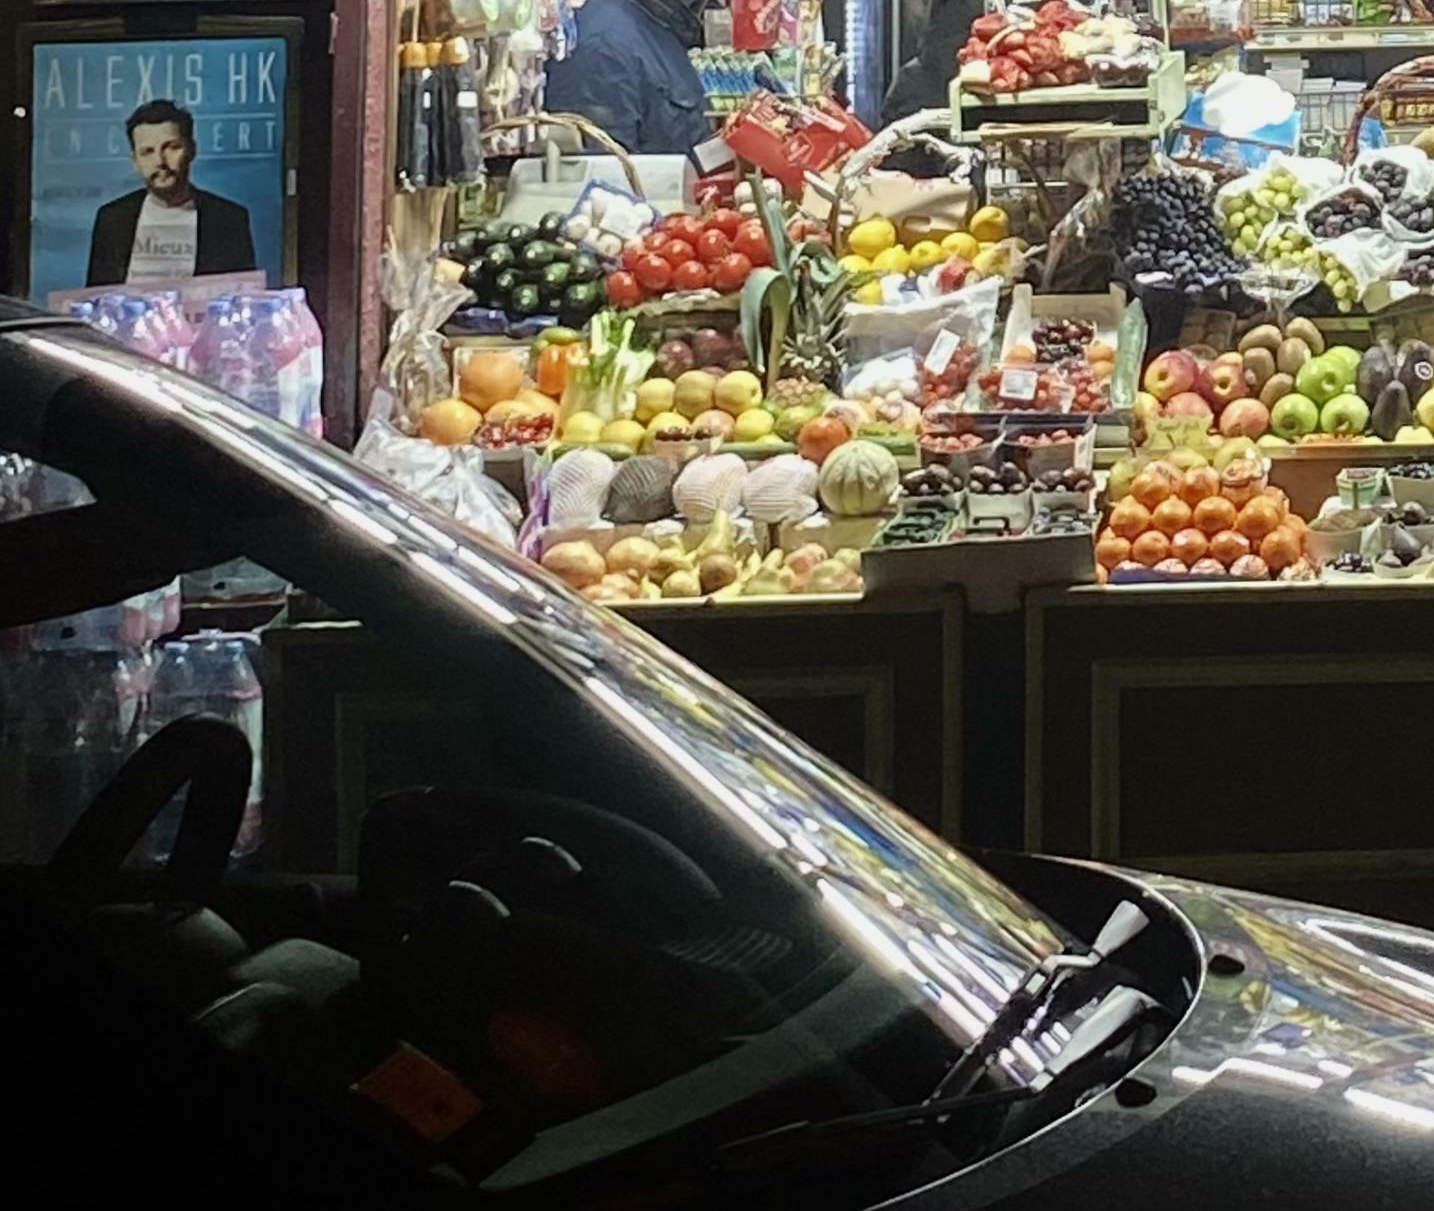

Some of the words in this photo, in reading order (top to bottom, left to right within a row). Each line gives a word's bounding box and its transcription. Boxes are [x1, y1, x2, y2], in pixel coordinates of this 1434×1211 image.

[44, 53, 203, 110] ALEXIS
[227, 51, 277, 105] HK
[107, 121, 277, 156] CERT
